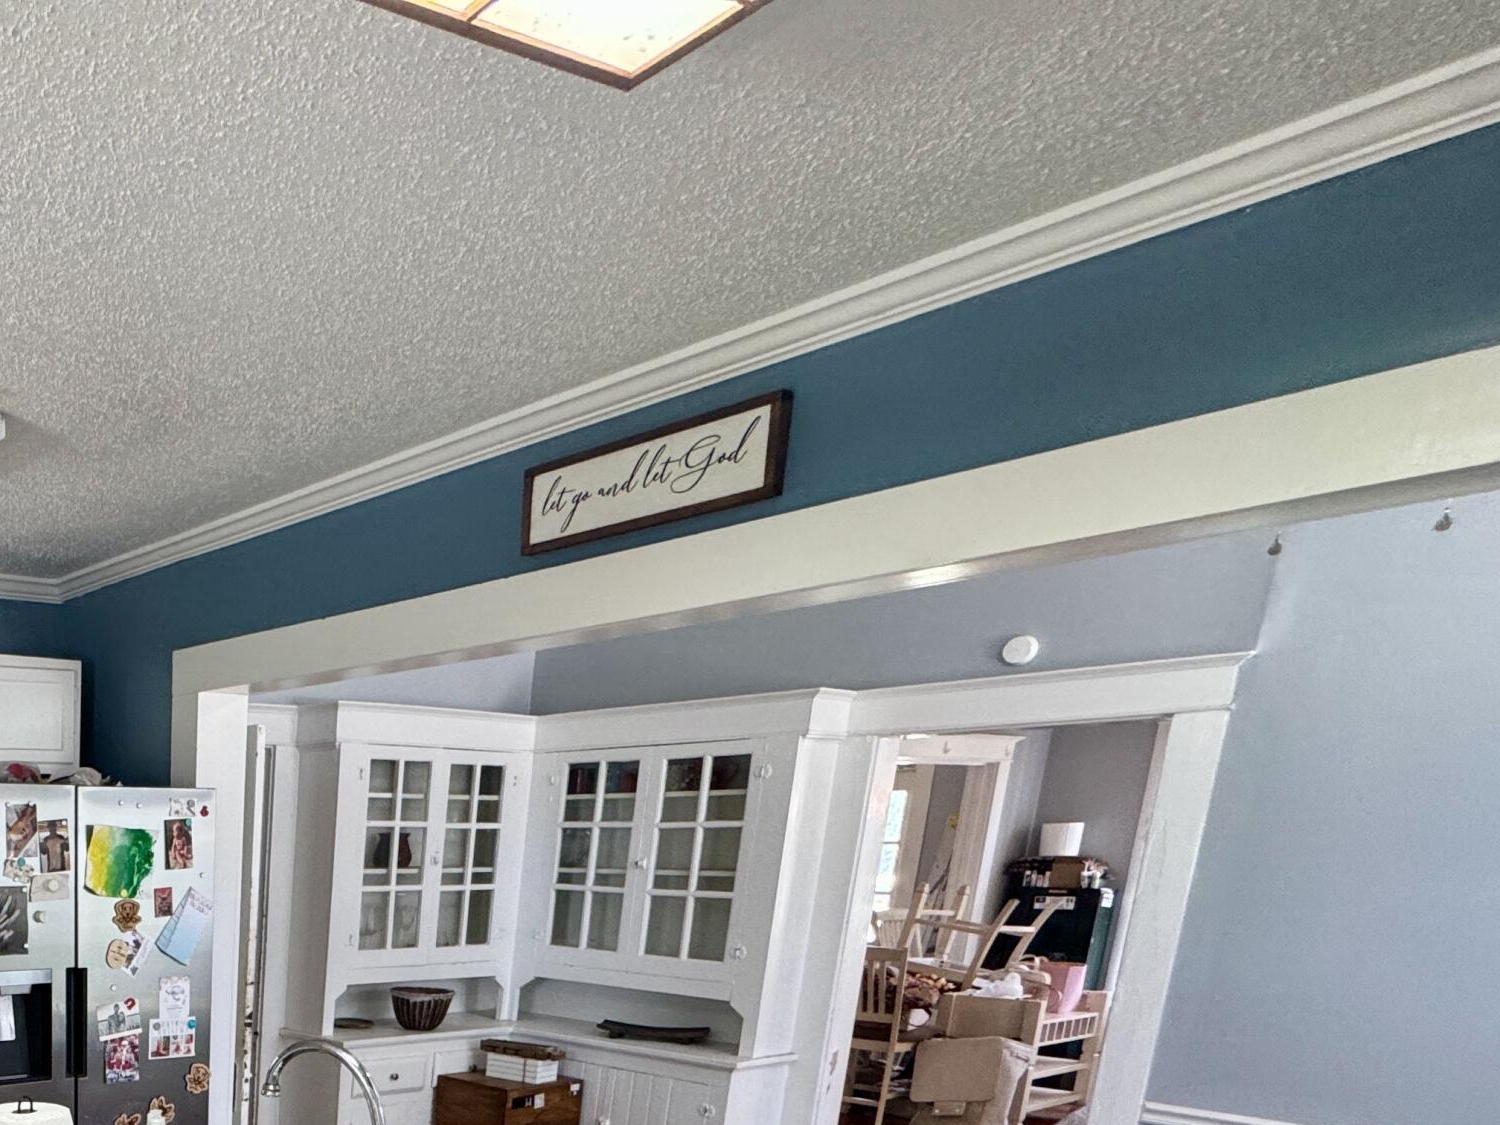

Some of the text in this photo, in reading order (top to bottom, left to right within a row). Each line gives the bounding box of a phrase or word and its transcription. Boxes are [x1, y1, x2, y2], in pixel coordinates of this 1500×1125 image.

[541, 415, 762, 533] let go and let God
